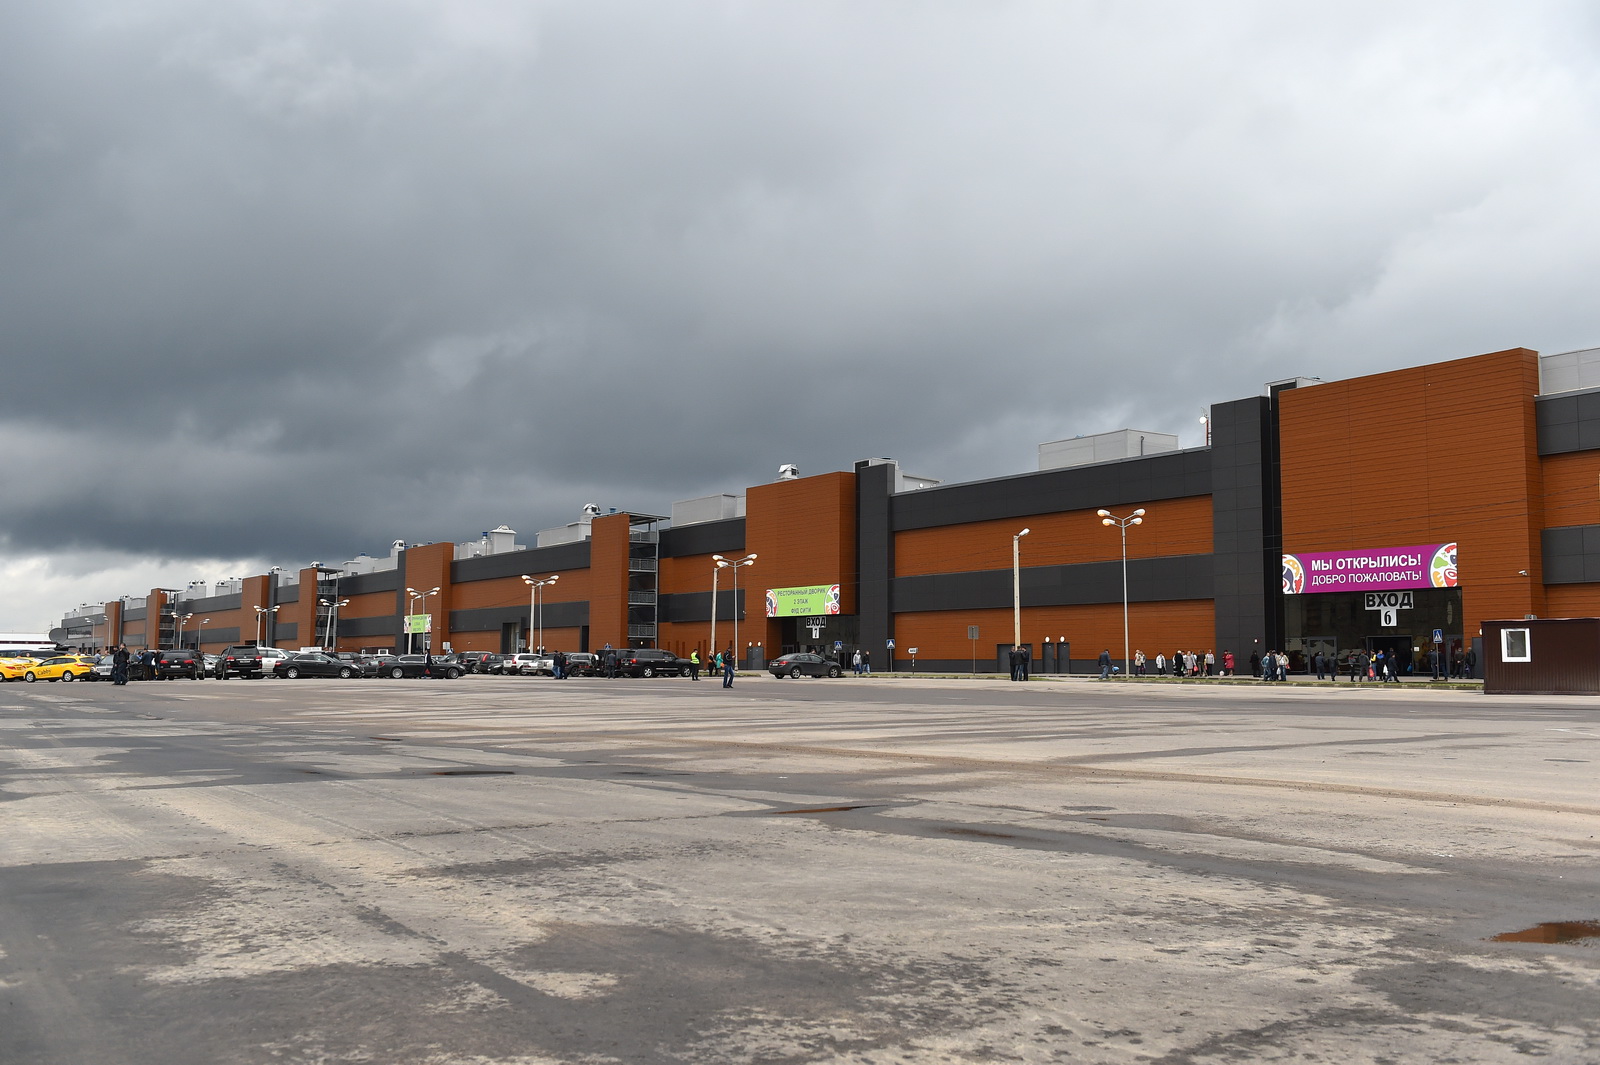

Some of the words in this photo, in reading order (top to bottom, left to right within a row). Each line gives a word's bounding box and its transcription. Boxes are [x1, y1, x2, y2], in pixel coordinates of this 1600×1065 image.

[1311, 559, 1333, 571] МЫ
[1336, 554, 1421, 570] ОТКРЫЛИСЬ!
[1311, 574, 1346, 586] ДОБРО
[1348, 571, 1422, 583] ПОЖАЛОВАТЬ!
[778, 588, 808, 596] РЕСТОРАННЫЙ
[1366, 592, 1412, 608] ВХОД
[806, 617, 826, 626] ВХОД
[1383, 610, 1392, 625] 6
